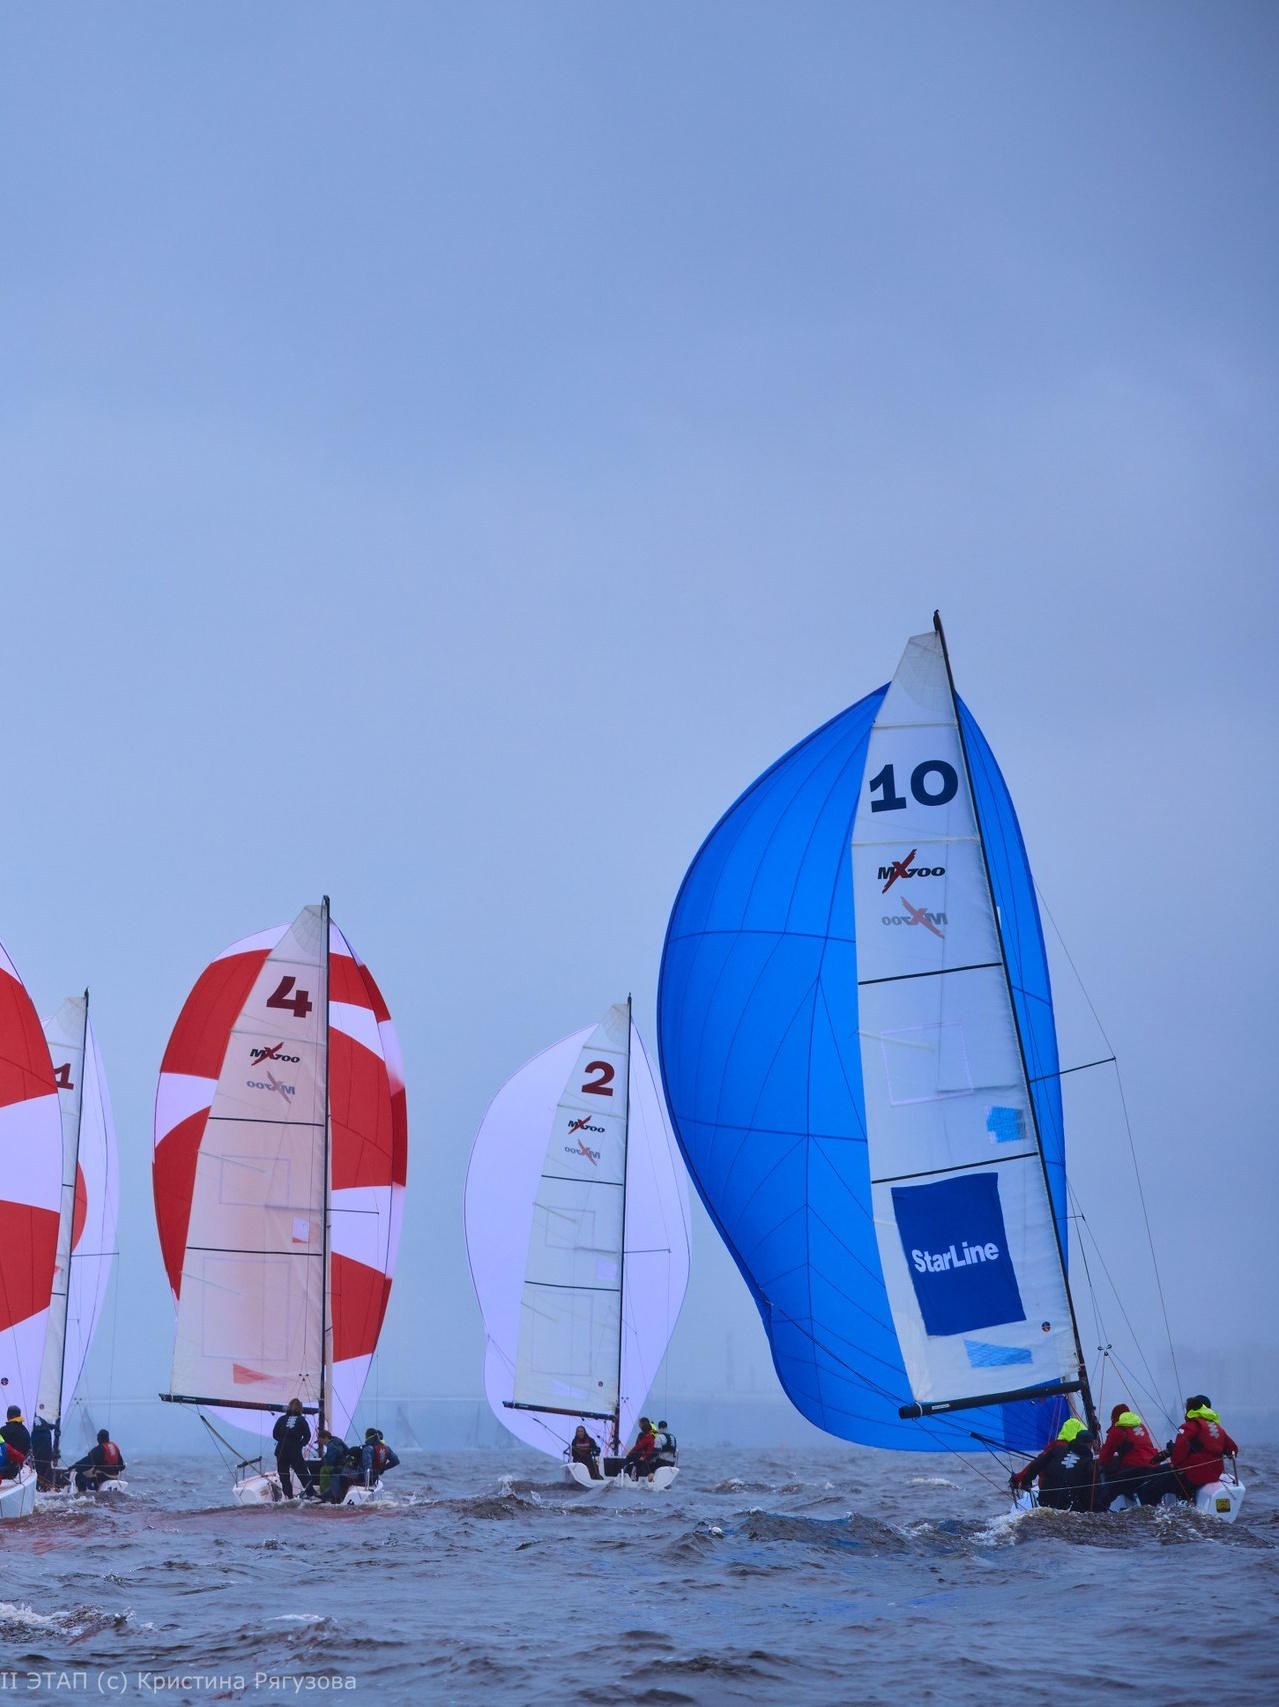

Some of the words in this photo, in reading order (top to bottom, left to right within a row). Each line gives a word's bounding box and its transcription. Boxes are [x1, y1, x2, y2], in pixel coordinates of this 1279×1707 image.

[869, 760, 958, 812] 10
[877, 849, 946, 894] MX700
[266, 976, 312, 1018] 4
[249, 1041, 300, 1066] MX700
[581, 1061, 615, 1097] 2
[568, 1115, 605, 1135] MX700
[911, 1241, 999, 1273] StarLine
